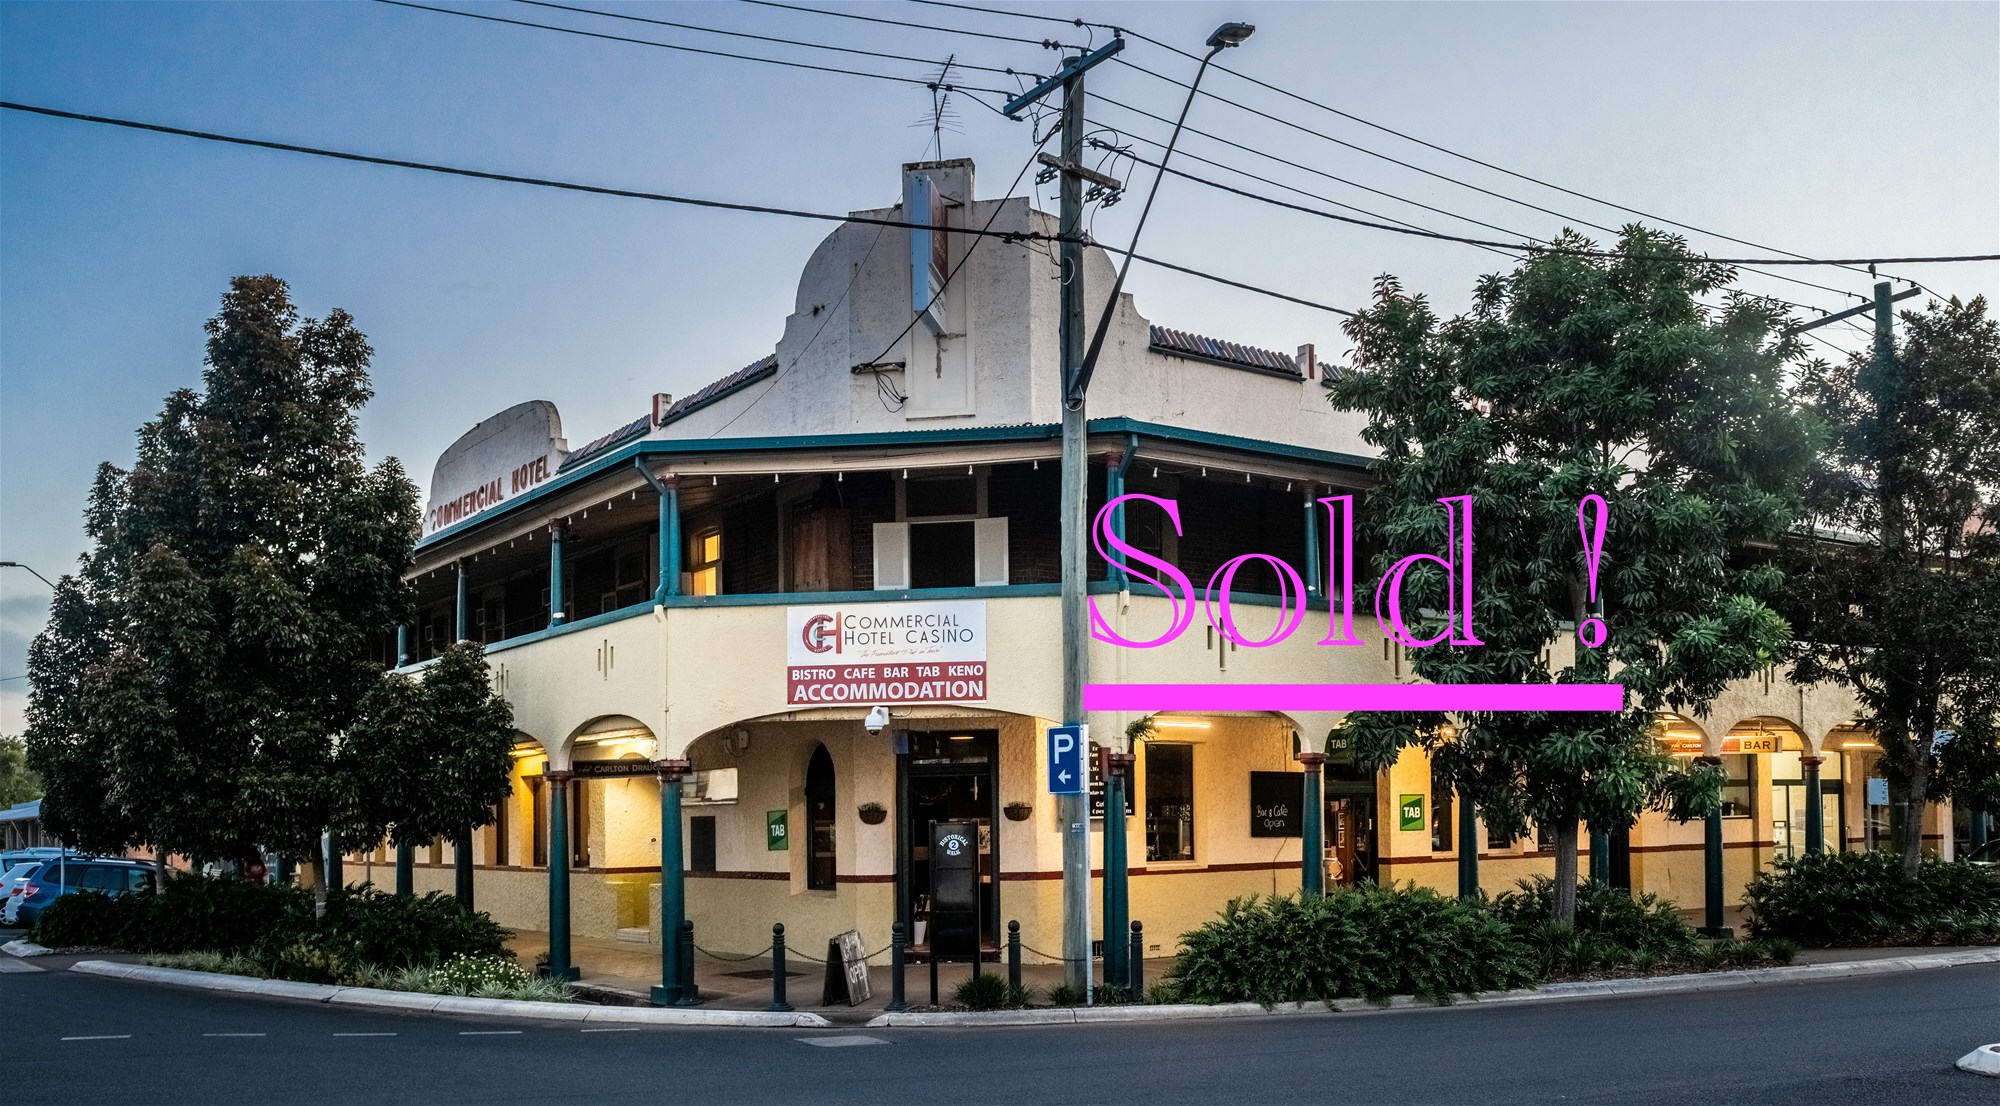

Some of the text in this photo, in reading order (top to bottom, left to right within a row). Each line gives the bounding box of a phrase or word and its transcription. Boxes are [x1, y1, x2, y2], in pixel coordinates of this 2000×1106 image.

[430, 455, 551, 532] COMMERCIAL HOTEL
[844, 613, 959, 630] COMMERCIAL
[844, 628, 974, 645] HOTEL CASINO
[792, 664, 984, 681] BISTRO CAFE BAR TAB KENO
[793, 680, 984, 702] ACCOMMODATION
[1054, 733, 1074, 765] P
[1330, 739, 1347, 749] TAB
[1744, 741, 1771, 750] BAR
[594, 765, 629, 773] CARLTON
[1256, 804, 1267, 818] Bar
[1403, 806, 1421, 818] TAB
[771, 824, 785, 837] TAB
[1263, 818, 1285, 831] Open
[939, 834, 969, 847] HISTORICAL
